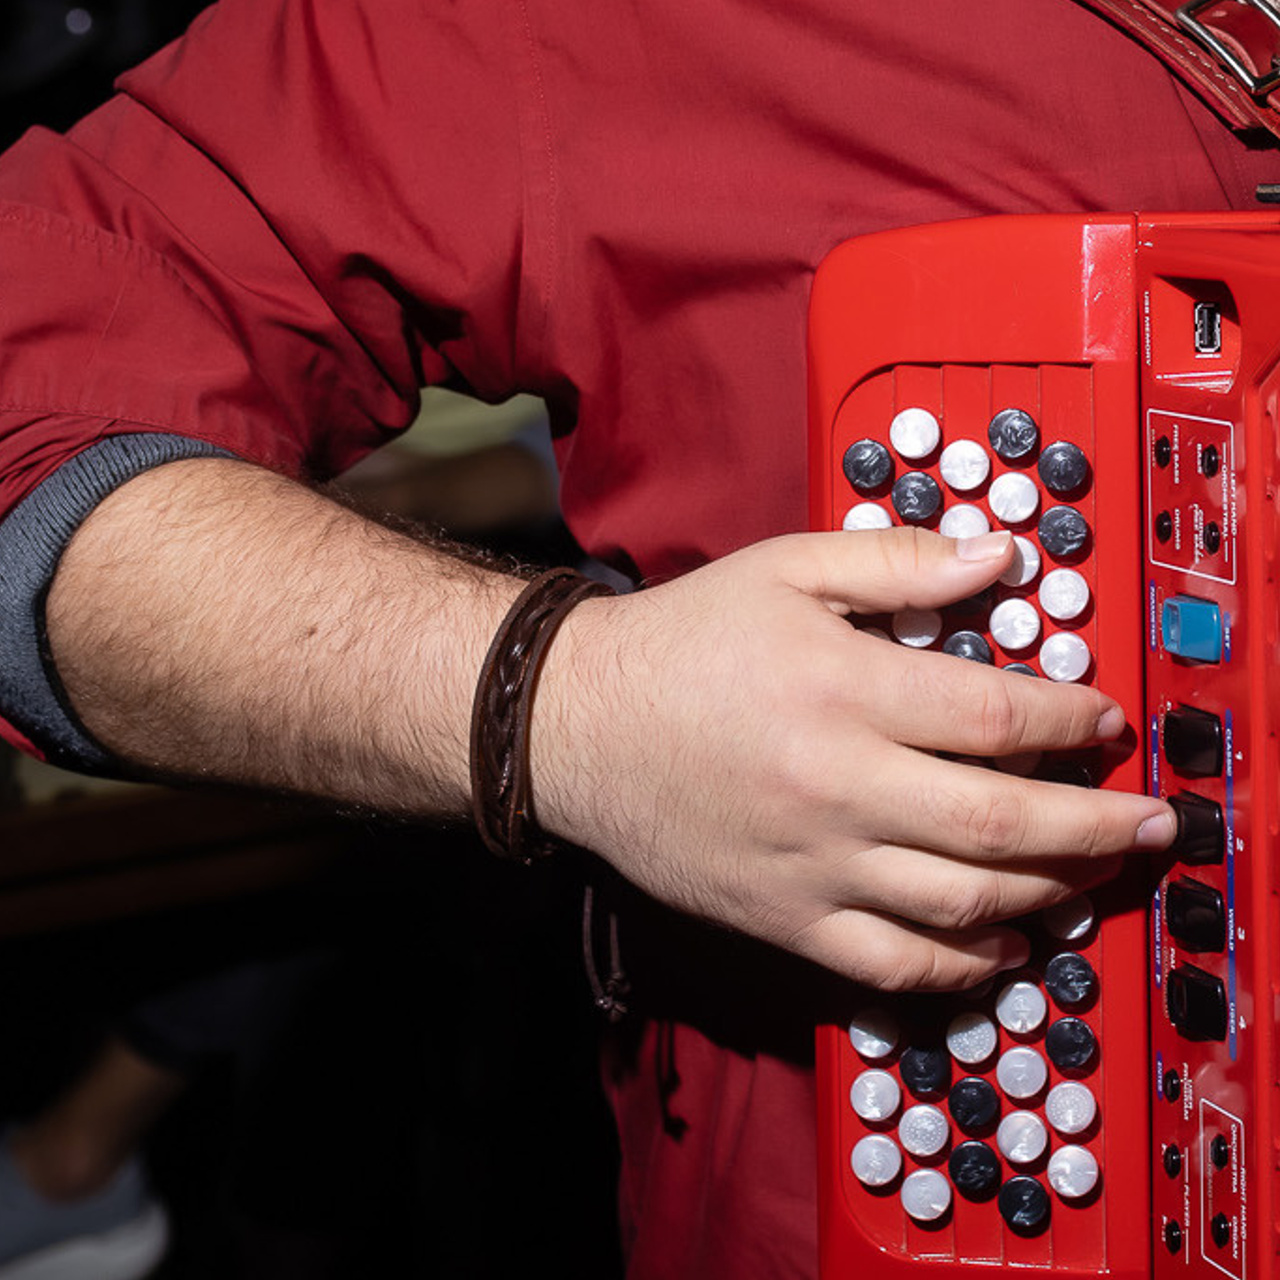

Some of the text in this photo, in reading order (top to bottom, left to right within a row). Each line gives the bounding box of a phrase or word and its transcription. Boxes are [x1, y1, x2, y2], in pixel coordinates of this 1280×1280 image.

[1235, 750, 1243, 761] 1
[1236, 837, 1244, 852] 2
[1237, 927, 1245, 941] 3
[1238, 1015, 1246, 1030] 4
